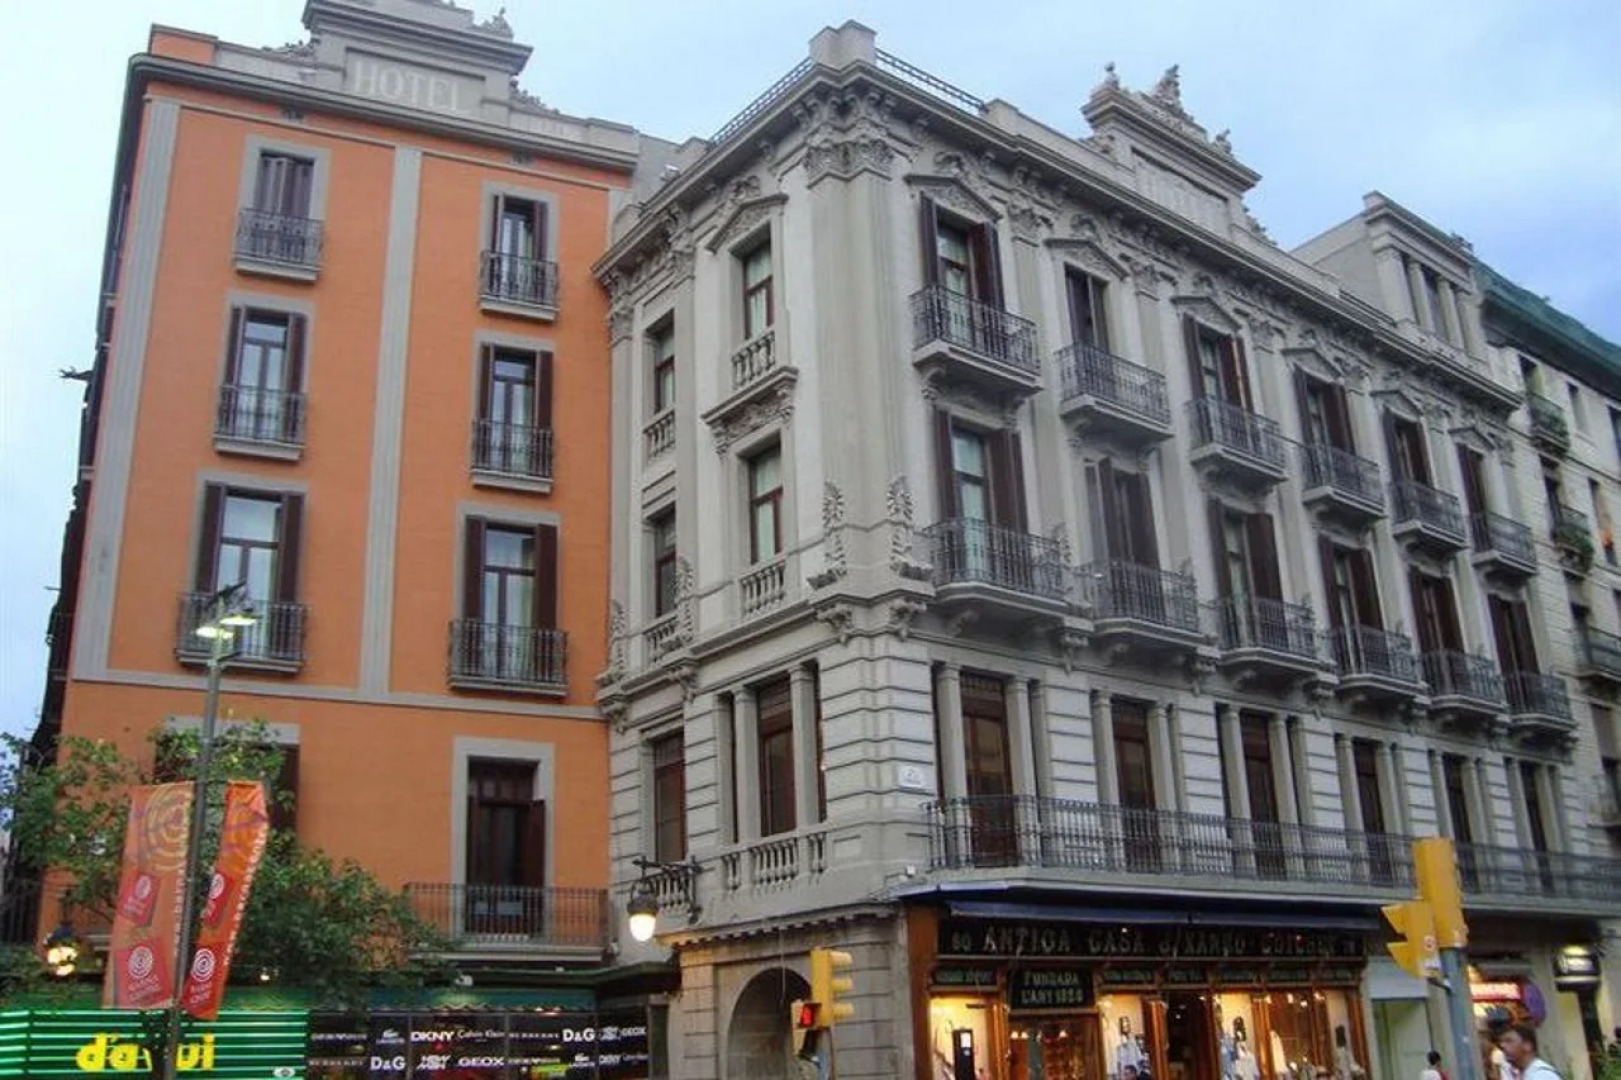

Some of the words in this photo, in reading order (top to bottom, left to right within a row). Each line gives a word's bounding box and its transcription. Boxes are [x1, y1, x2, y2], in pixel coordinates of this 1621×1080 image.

[354, 60, 459, 112] HOTEL
[982, 926, 1070, 953] ANTIGA
[1089, 929, 1145, 953] CASA
[411, 1031, 455, 1042] DKNY
[562, 1028, 596, 1043] D&G
[370, 1056, 406, 1071] D&G
[458, 1056, 505, 1068] GEOX
